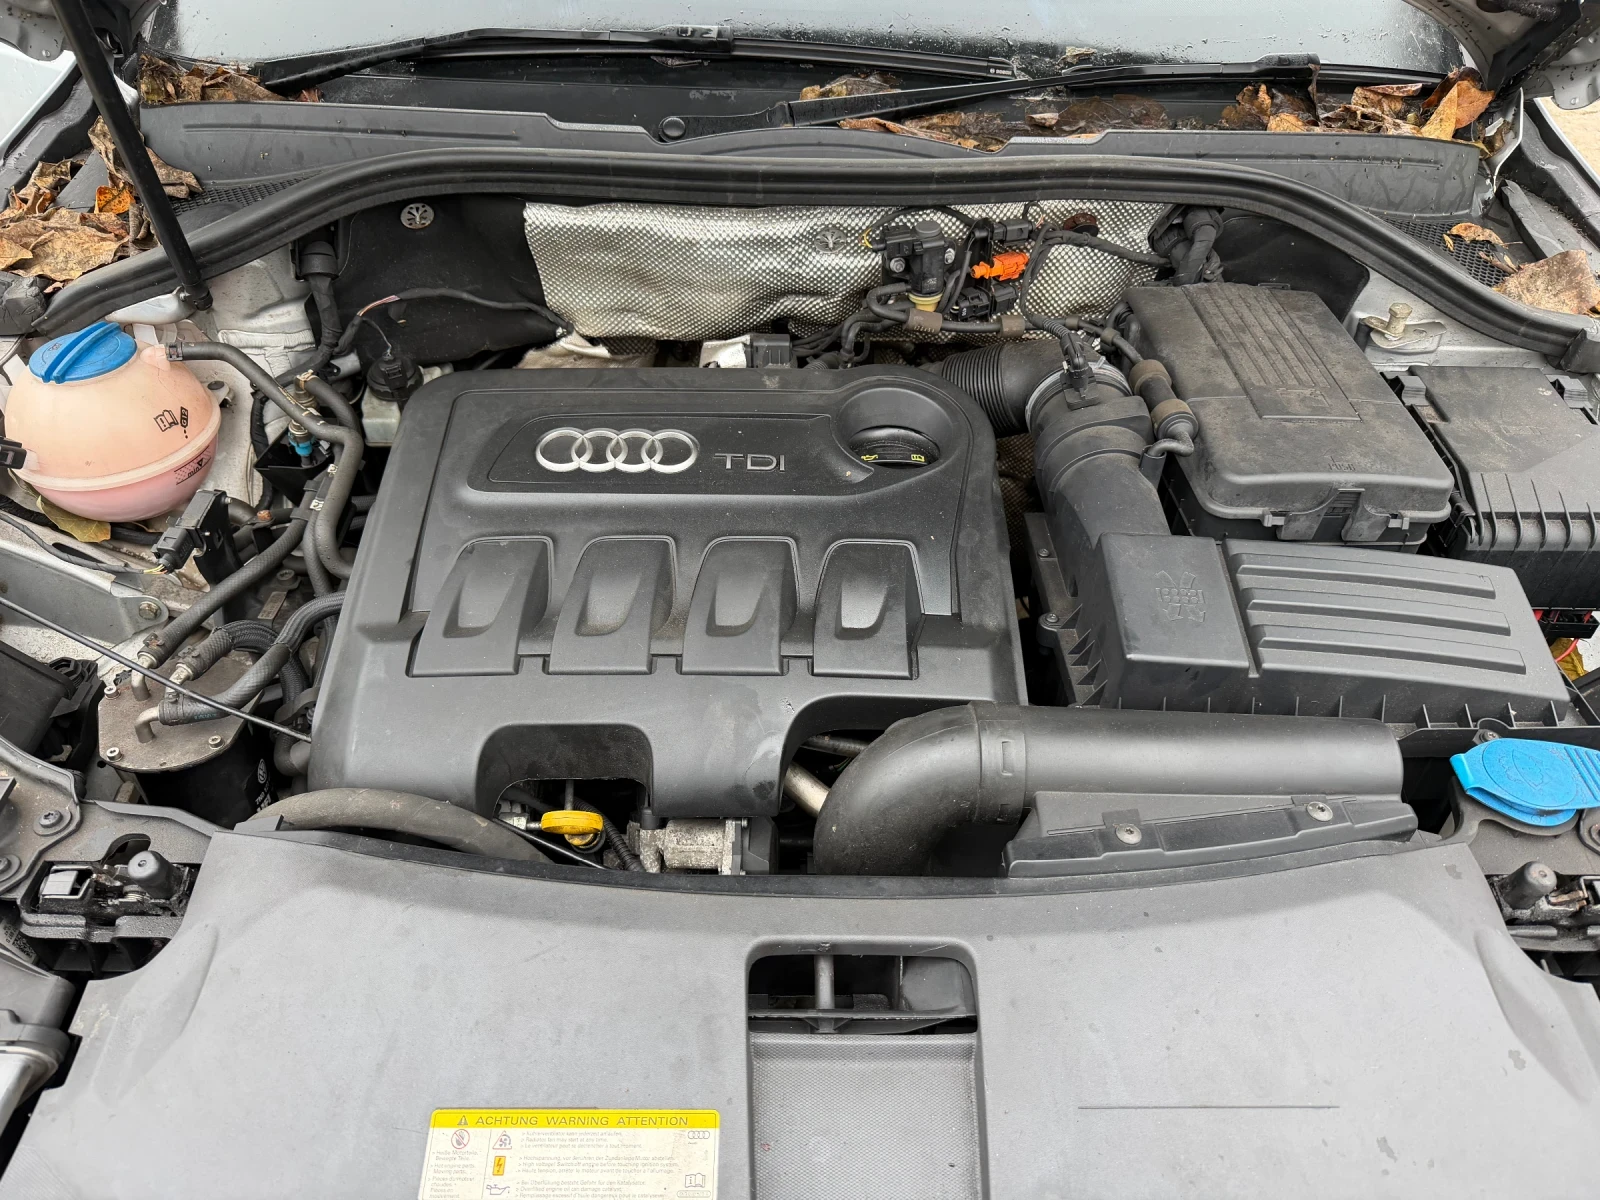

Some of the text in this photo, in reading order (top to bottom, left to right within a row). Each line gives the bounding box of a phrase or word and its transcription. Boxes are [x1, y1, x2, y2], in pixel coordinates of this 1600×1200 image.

[714, 452, 785, 471] TDI
[187, 466, 200, 478] min
[475, 1116, 688, 1126] ACHTUNG WARNING ATTENTION
